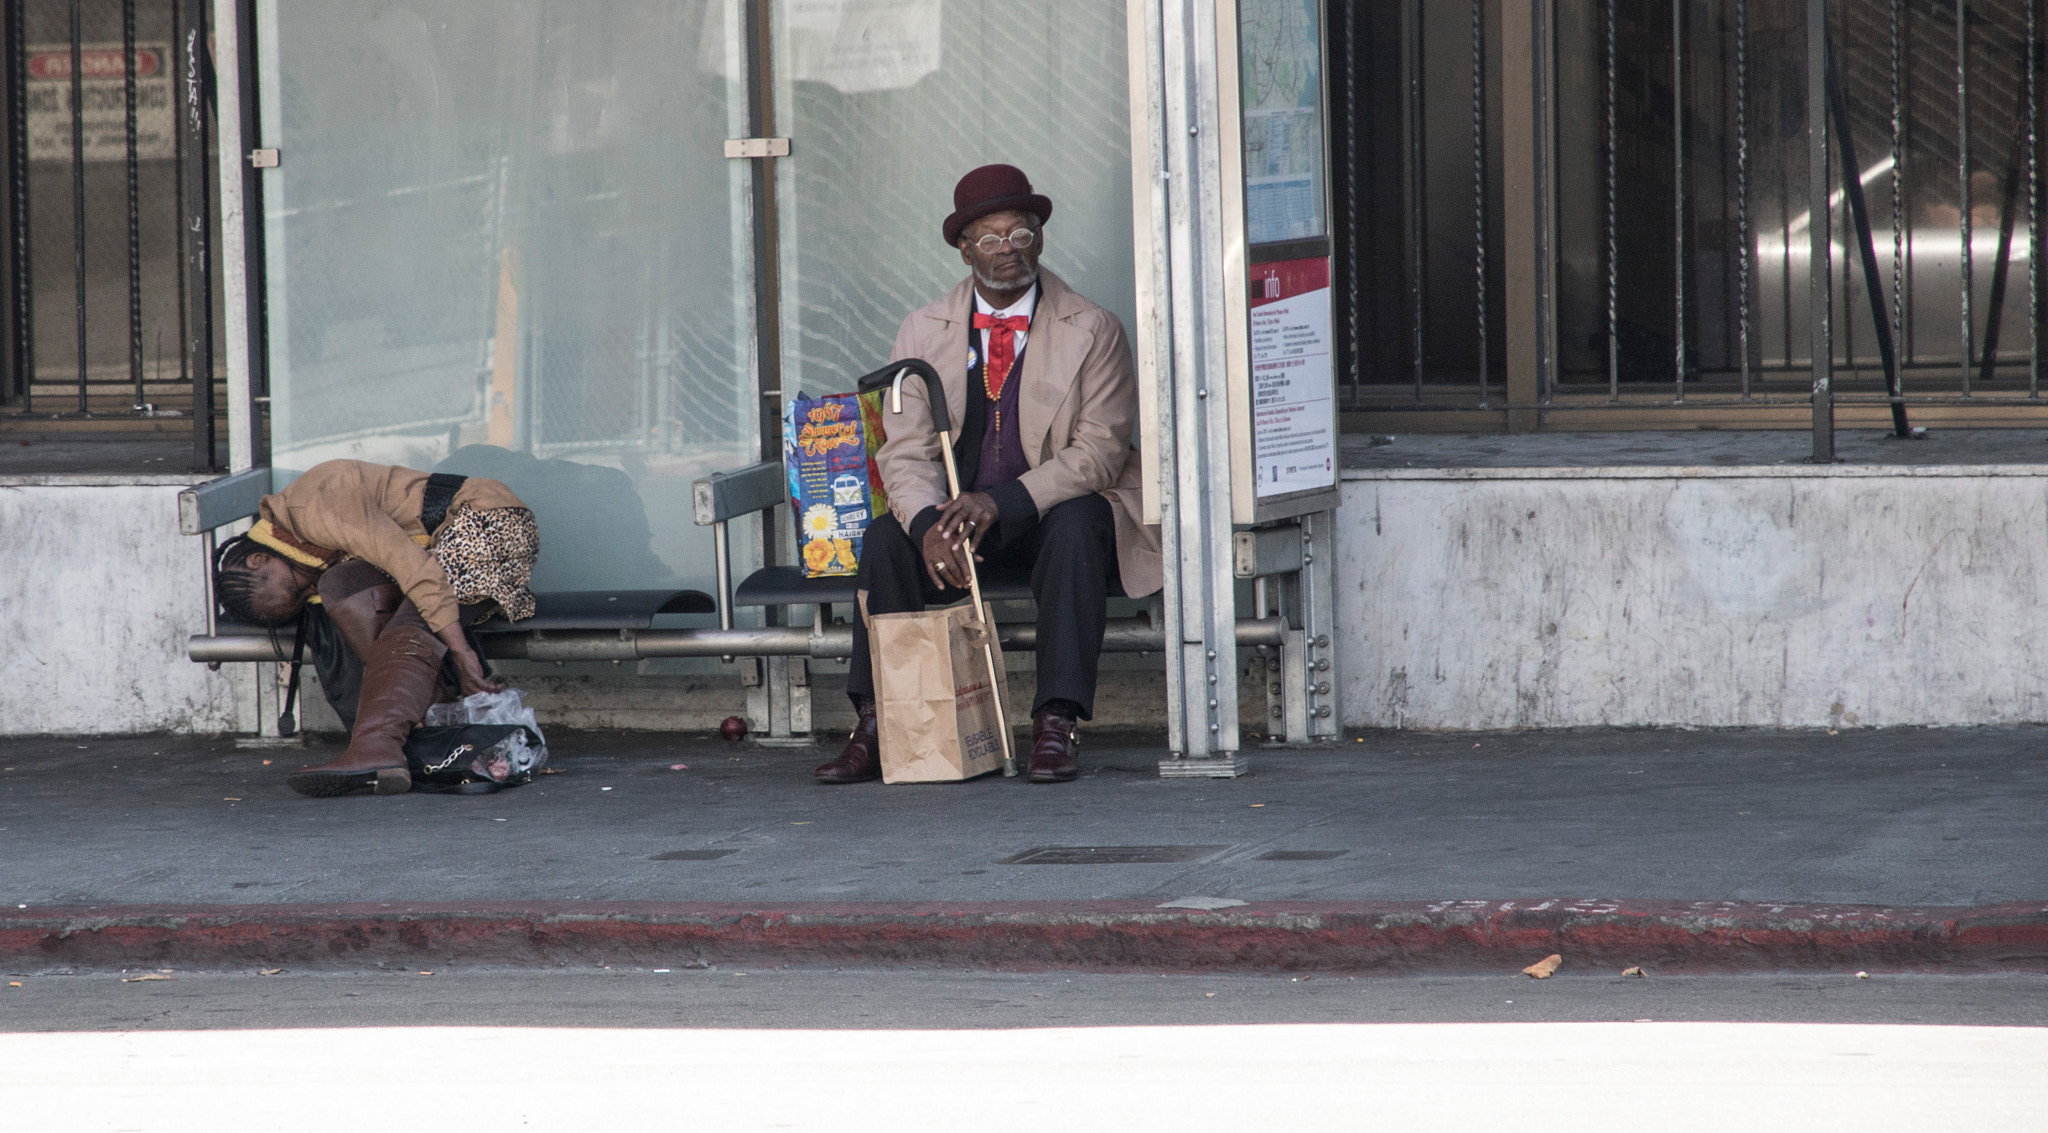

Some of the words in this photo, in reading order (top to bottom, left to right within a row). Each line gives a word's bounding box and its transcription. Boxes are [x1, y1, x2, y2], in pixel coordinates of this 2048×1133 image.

[1264, 269, 1280, 298] info
[807, 402, 844, 426] 1967
[801, 422, 845, 438] Summer
[843, 420, 857, 438] of
